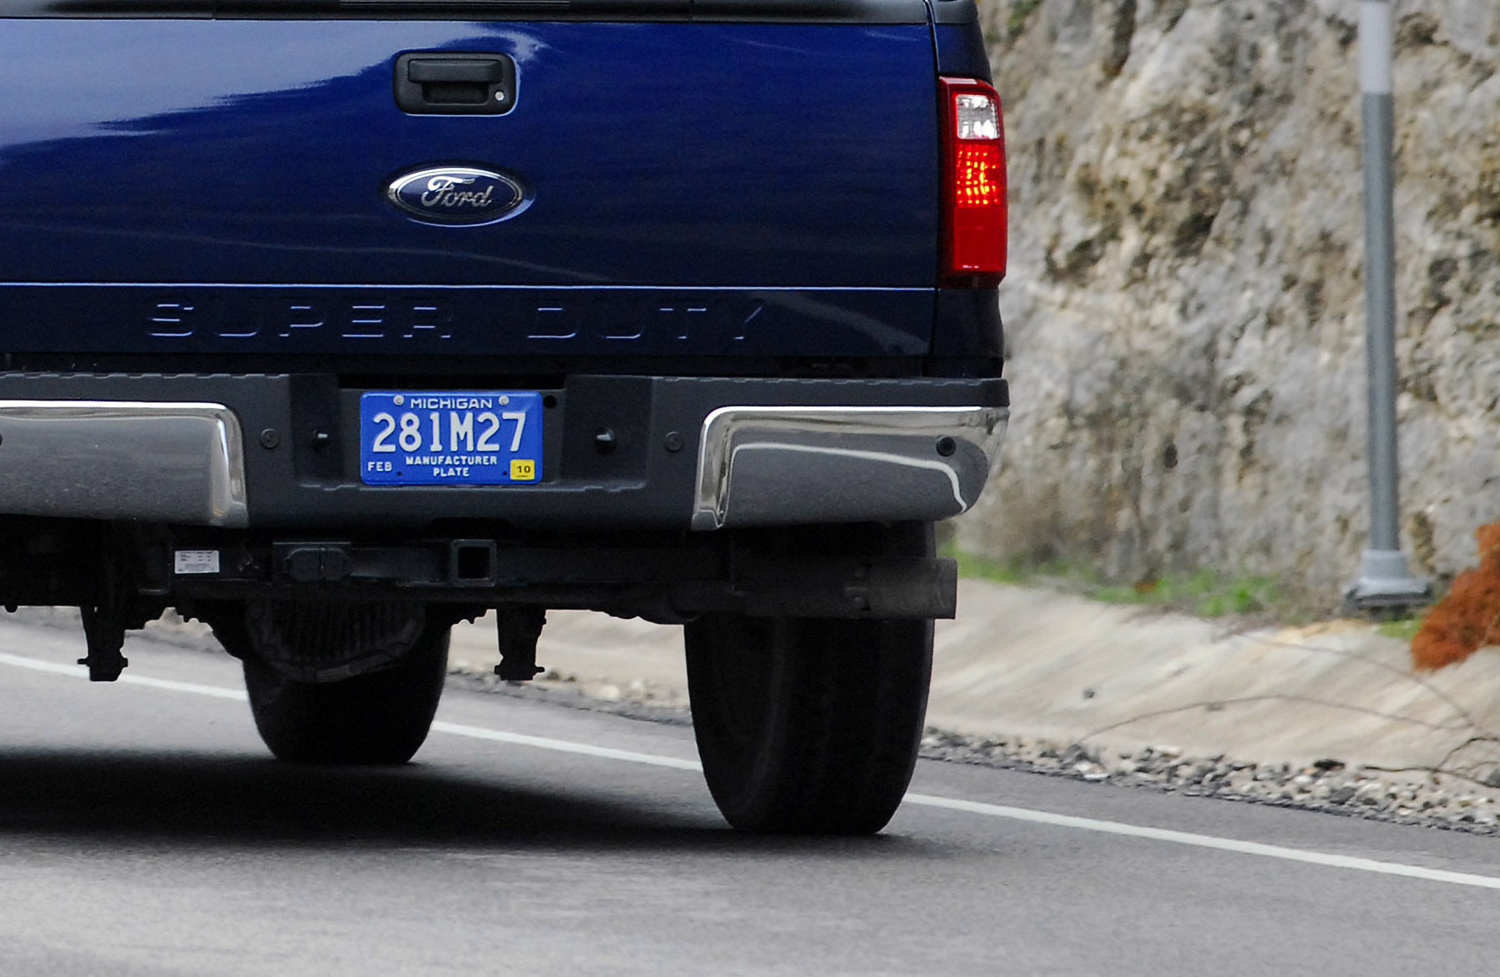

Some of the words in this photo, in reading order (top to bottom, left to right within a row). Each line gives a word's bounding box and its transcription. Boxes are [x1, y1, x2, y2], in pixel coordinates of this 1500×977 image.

[421, 175, 494, 207] Ford
[147, 299, 453, 338] SUPER
[526, 301, 765, 340] DUTY
[410, 398, 493, 409] MICHIGAN
[372, 412, 526, 452] 281M27
[406, 456, 498, 465] MANUFACTURER
[367, 461, 393, 472] FEB
[433, 467, 470, 477] PLATE
[516, 465, 531, 473] 10
